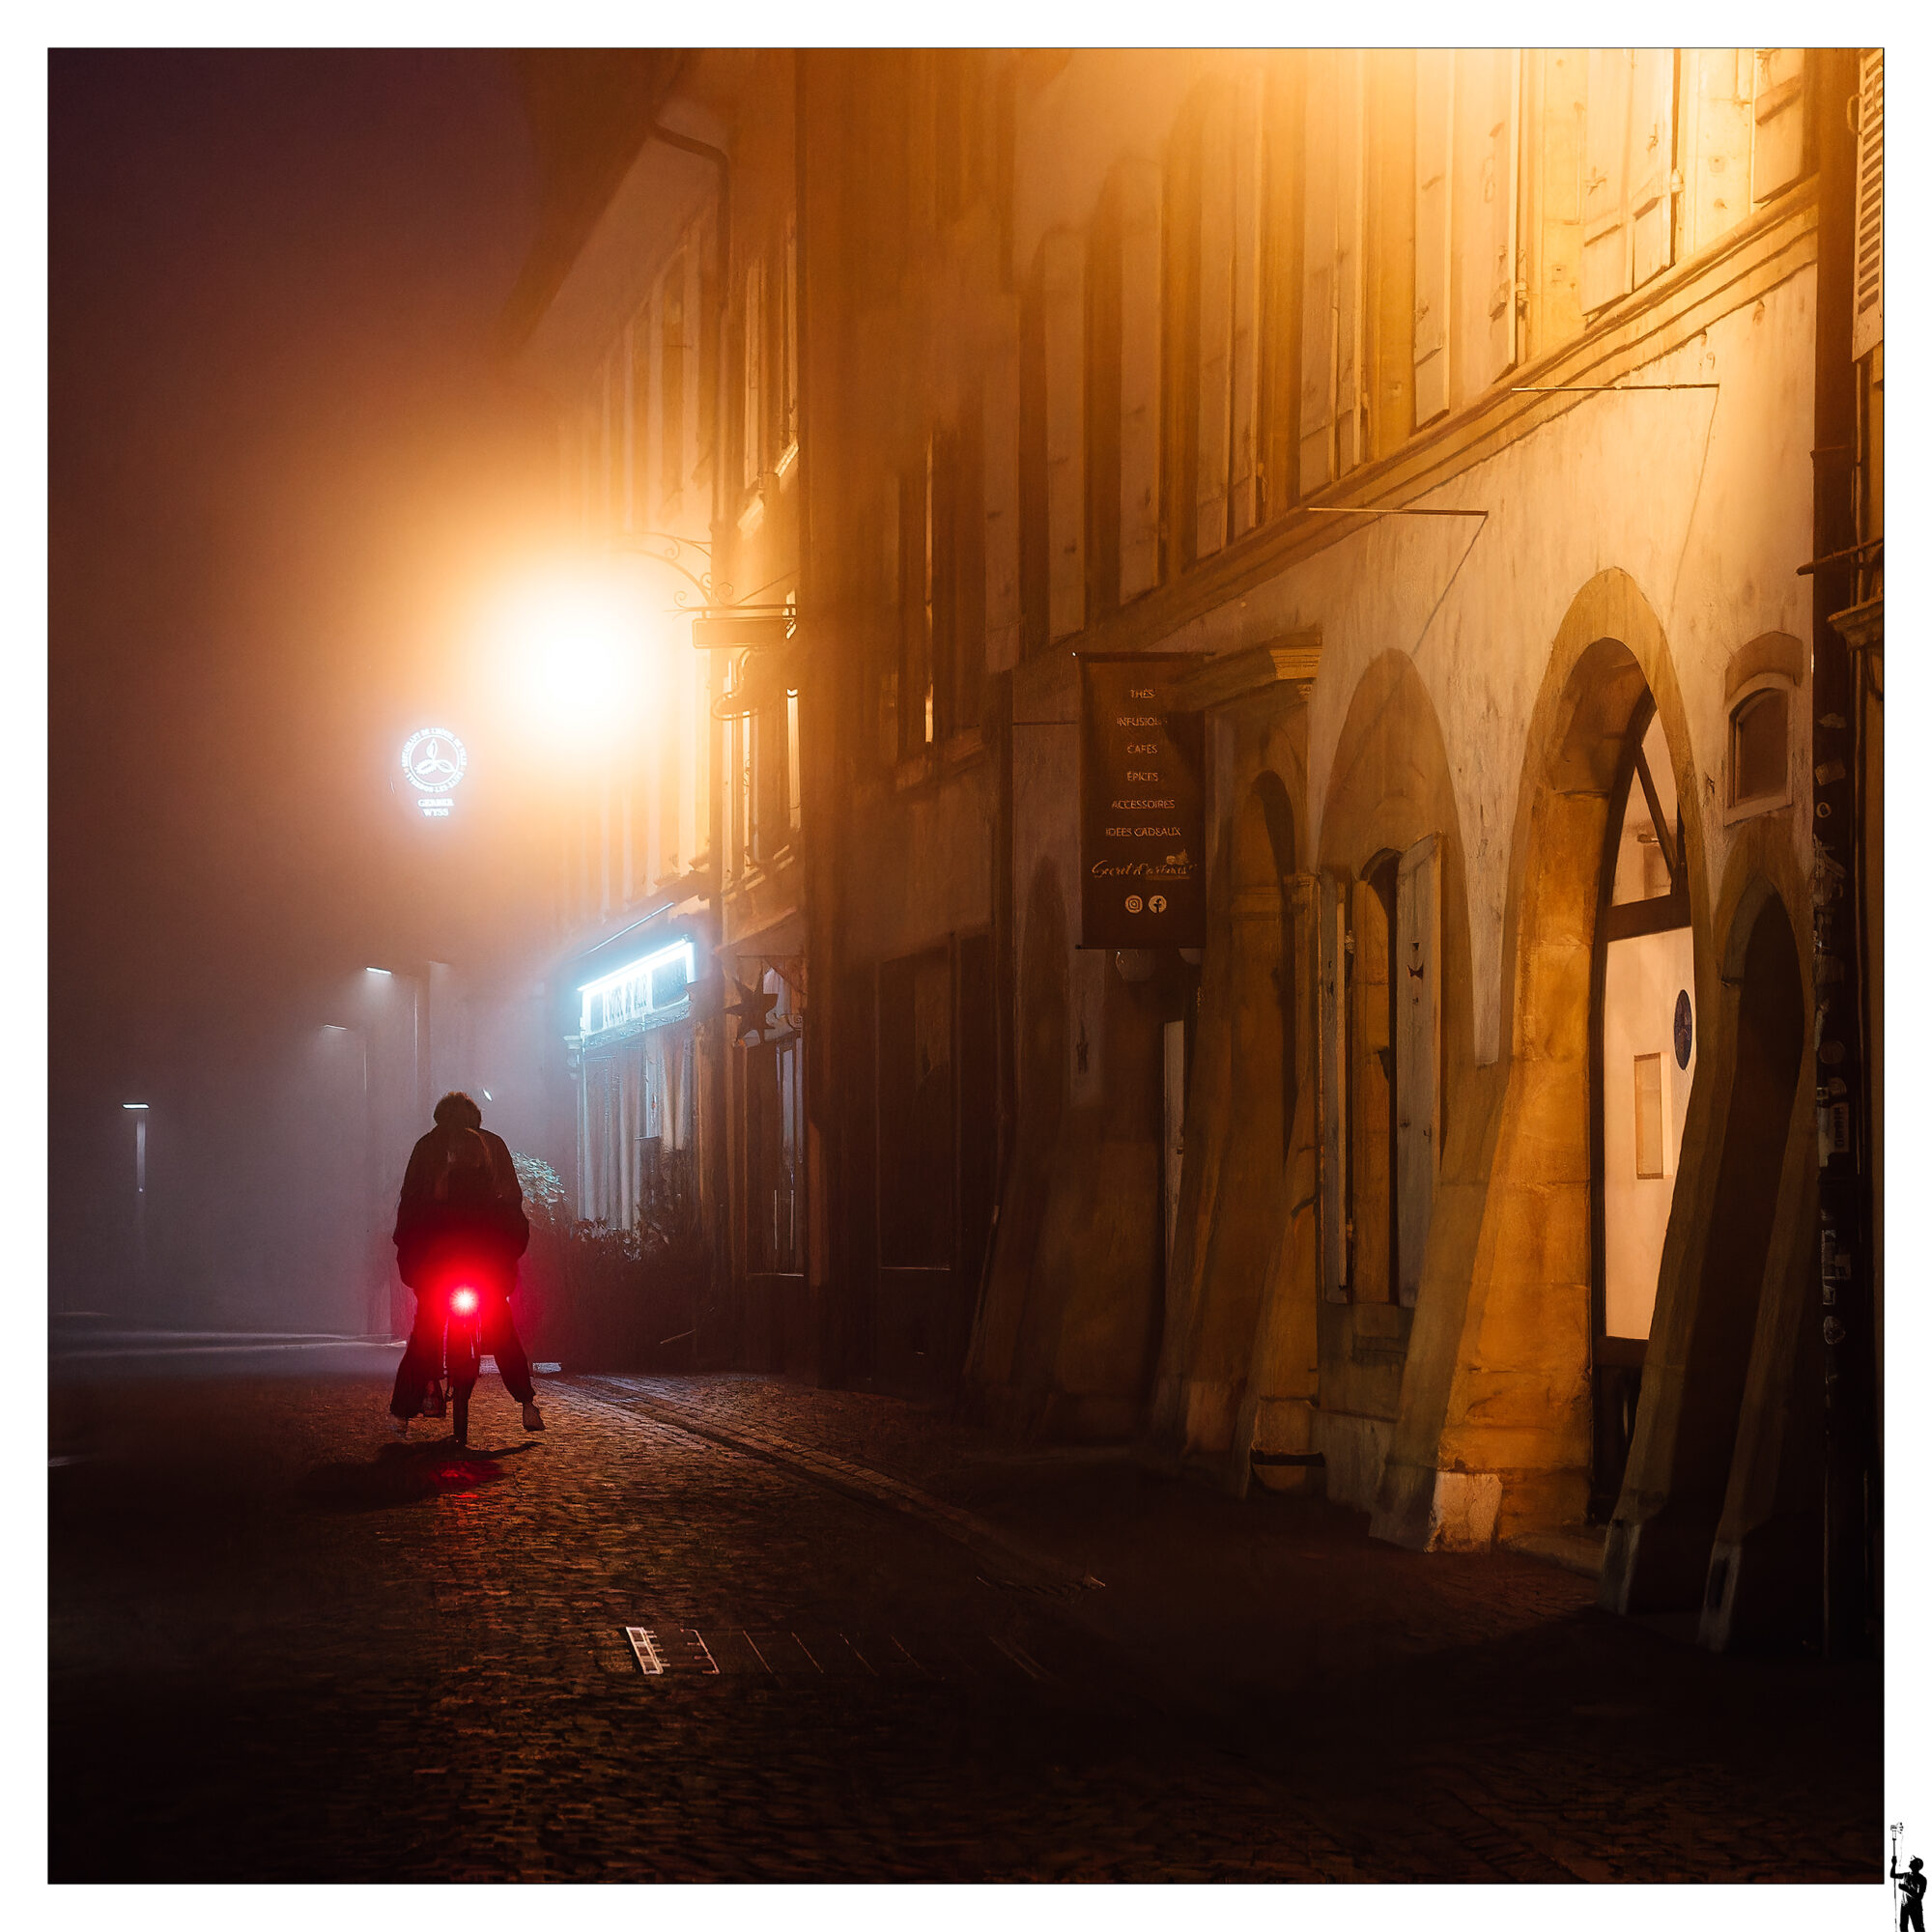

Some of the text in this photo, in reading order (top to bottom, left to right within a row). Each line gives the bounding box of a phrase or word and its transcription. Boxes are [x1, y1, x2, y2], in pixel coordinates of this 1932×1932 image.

[1117, 717, 1168, 727] INFUSIO
[1111, 800, 1176, 810] ACCESSOIRES
[1134, 827, 1181, 838] CADEAUX
